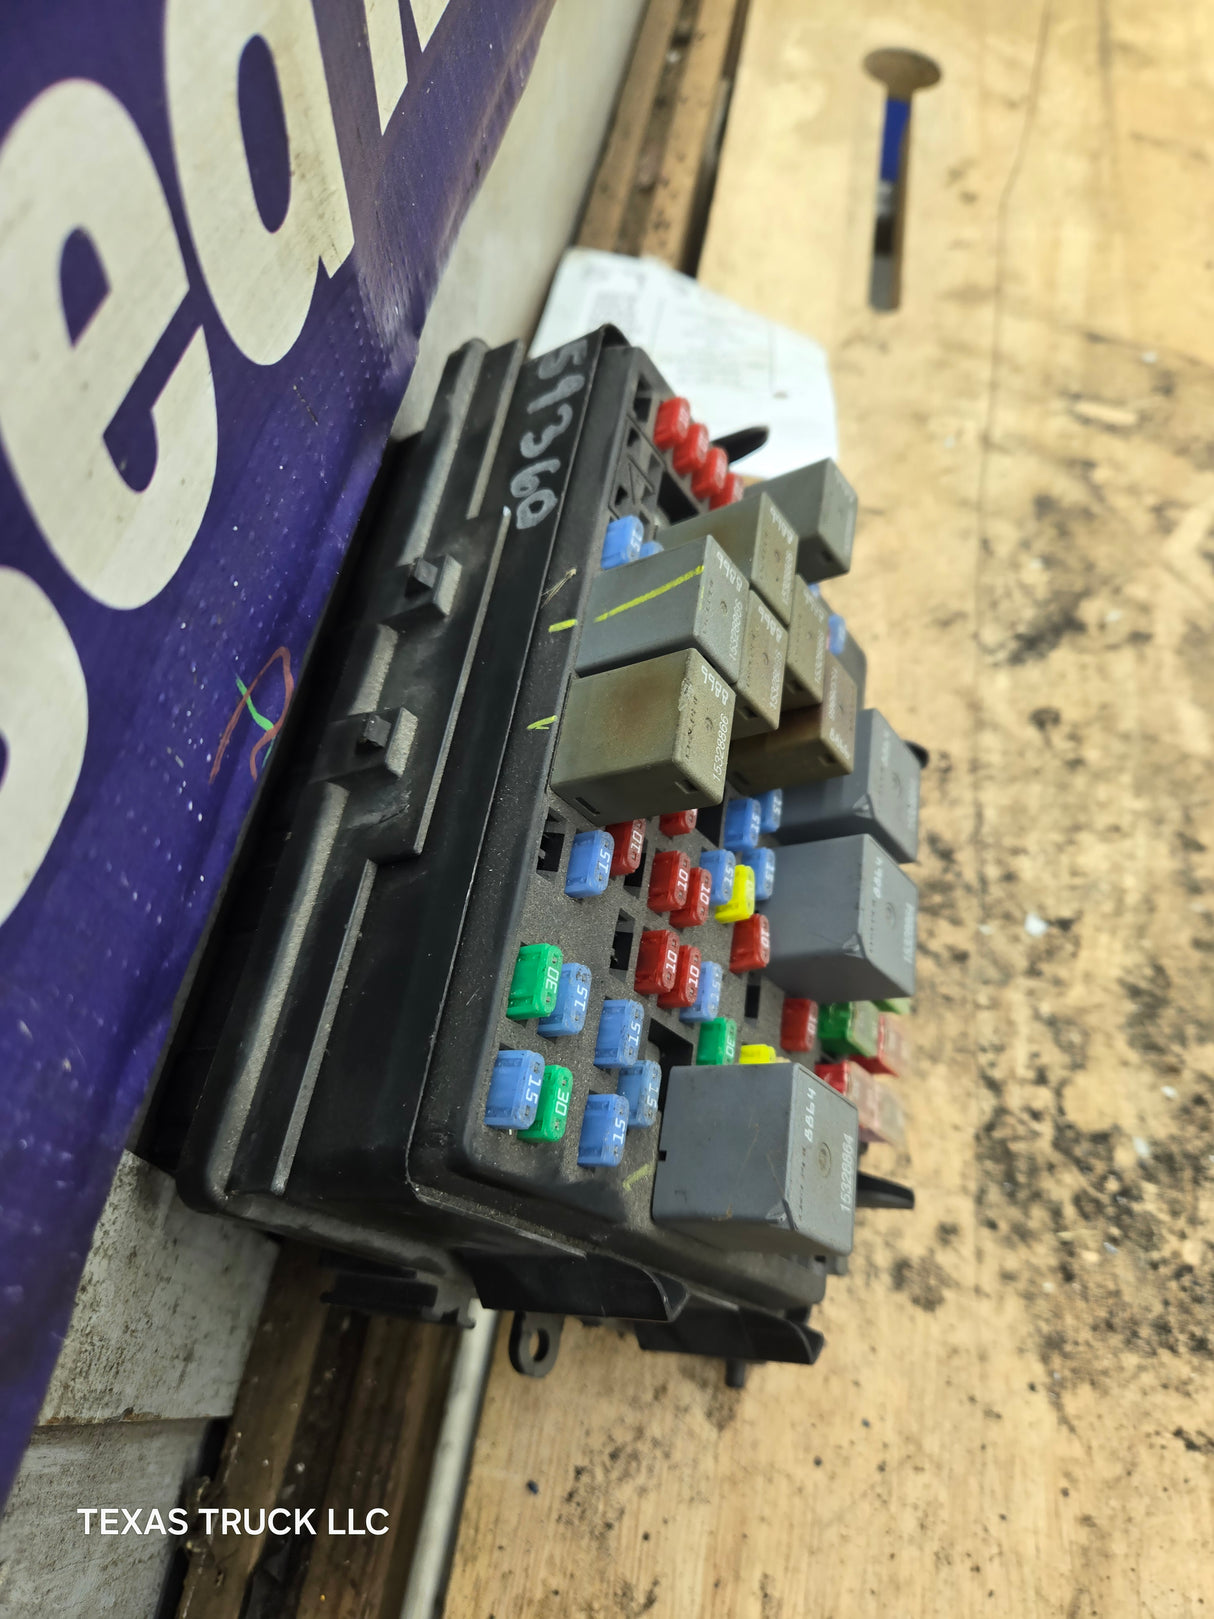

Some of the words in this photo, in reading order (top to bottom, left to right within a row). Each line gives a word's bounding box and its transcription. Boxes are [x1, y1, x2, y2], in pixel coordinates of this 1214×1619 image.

[712, 712, 729, 781] 15328866
[749, 813, 761, 837] 15
[631, 829, 644, 854] 10
[599, 848, 612, 874] 15
[677, 868, 690, 892] 10
[722, 864, 735, 888] 15
[699, 883, 711, 906] 10
[758, 925, 771, 947] 10
[665, 949, 678, 975] 10
[545, 965, 560, 994] 30
[687, 964, 700, 988] 10
[573, 983, 589, 1012] 15
[628, 1021, 642, 1047] 15
[525, 1074, 542, 1104] 15
[554, 1087, 570, 1117] 30
[646, 1082, 660, 1109] 15
[611, 1118, 626, 1145] 15
[840, 1132, 855, 1212] 15328864
